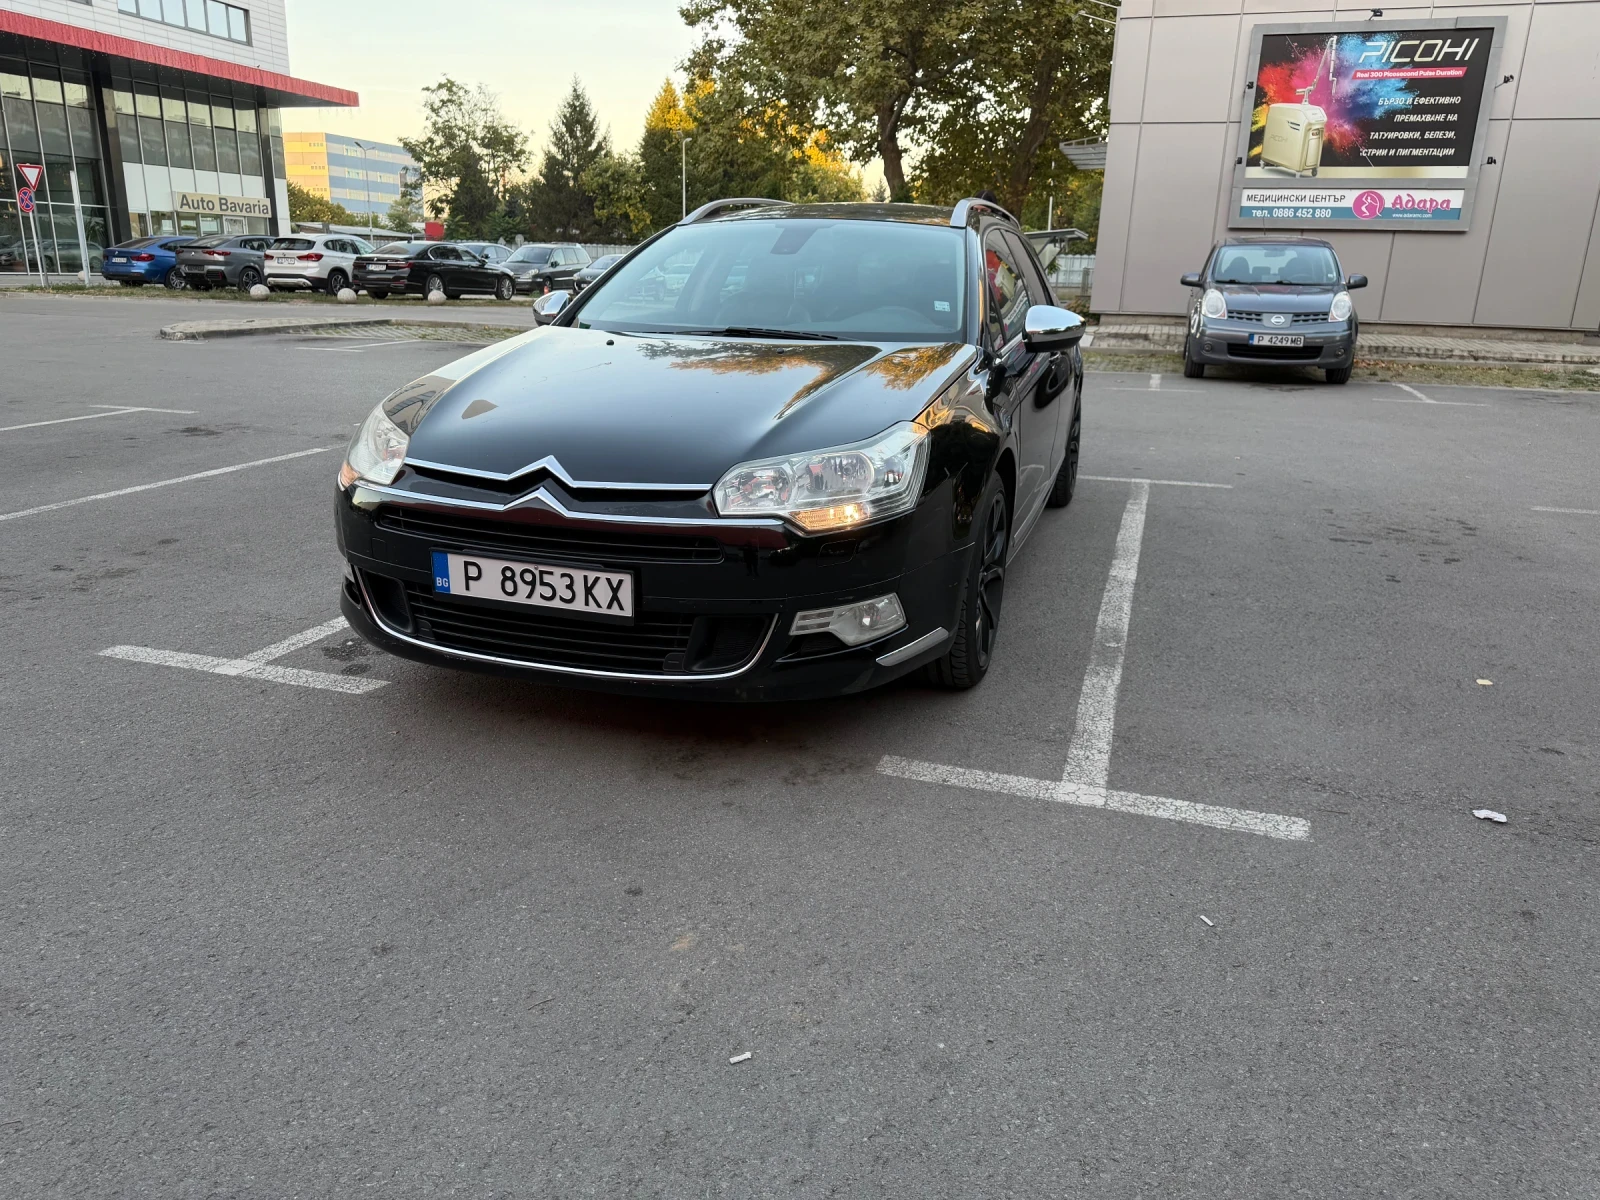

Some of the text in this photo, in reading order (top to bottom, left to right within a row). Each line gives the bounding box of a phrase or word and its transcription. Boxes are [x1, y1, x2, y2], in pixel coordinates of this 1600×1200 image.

[1358, 38, 1480, 63] PICOHI
[1378, 96, 1461, 105] БЪРЗО И ЕФЕКТИВНО
[1394, 114, 1446, 122] ПРЕМАХВАНЕ
[1370, 131, 1421, 140] ТАТУИРОВКИ,
[1389, 148, 1395, 156] И
[1396, 148, 1455, 157] ПИГМЕНТАЦИИ
[1246, 194, 1346, 203] МЕДИЦИНСКИ ЦЕНТЪР
[1391, 193, 1451, 213] Адара
[180, 194, 269, 215] Auto Bavaria
[1252, 208, 1332, 218] тел. 0886 452 880
[1257, 335, 1264, 344] P
[463, 560, 482, 591] P
[436, 577, 449, 588] BG
